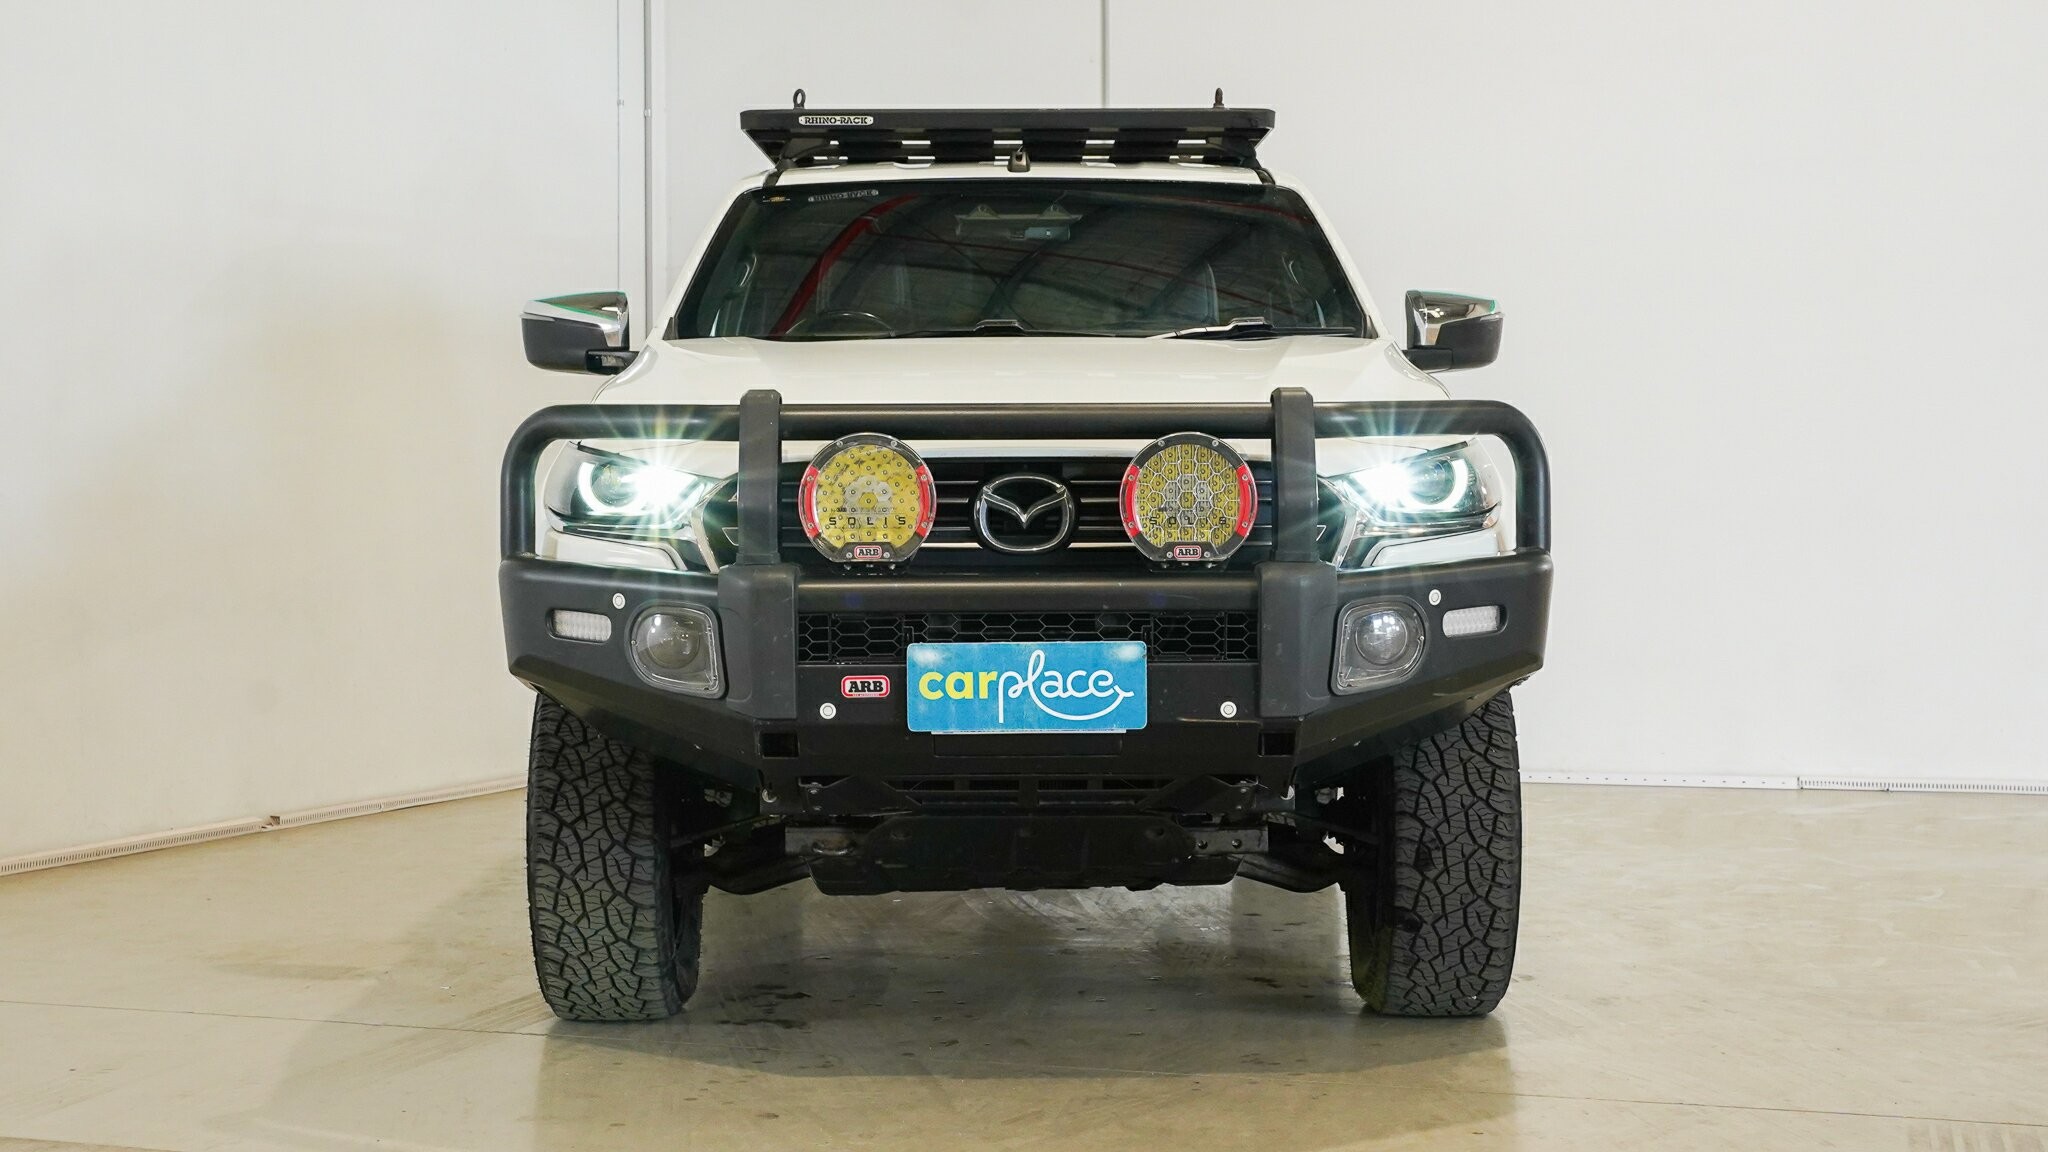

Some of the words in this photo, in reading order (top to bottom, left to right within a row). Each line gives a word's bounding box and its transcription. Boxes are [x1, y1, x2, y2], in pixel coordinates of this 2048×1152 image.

[804, 116, 868, 125] RHINO-RACK
[828, 516, 906, 526] SOLIS
[857, 548, 879, 557] ARB
[1177, 548, 1199, 557] ARB
[848, 680, 884, 693] ARB
[918, 649, 1135, 724] carplace
